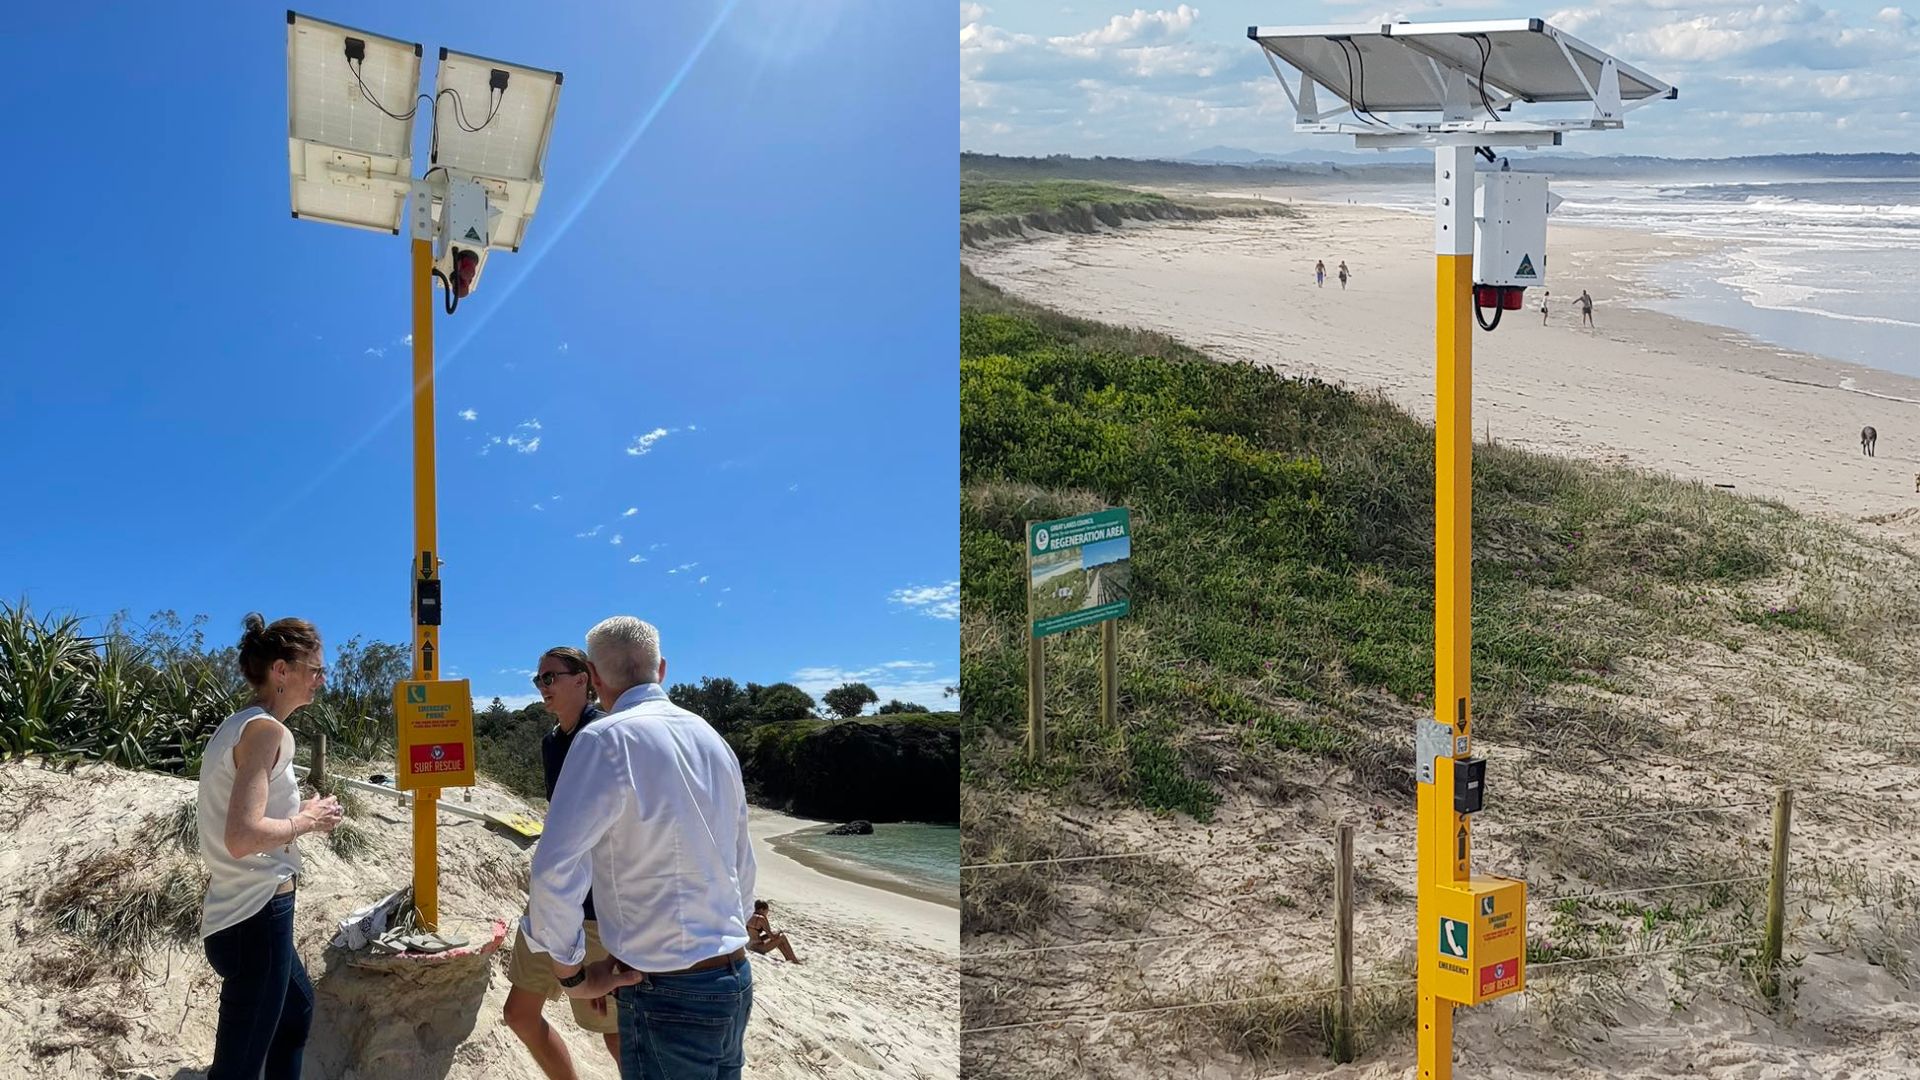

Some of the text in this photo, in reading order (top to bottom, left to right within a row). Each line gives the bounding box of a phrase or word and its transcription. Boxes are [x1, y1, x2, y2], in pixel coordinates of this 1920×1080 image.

[1050, 529, 1105, 550] REGENERATION
[1106, 525, 1125, 538] AREA
[414, 760, 462, 773] SURF RESCUE
[1439, 961, 1469, 975] EMERGENCY
[1482, 975, 1516, 994] SURF RESCUE
